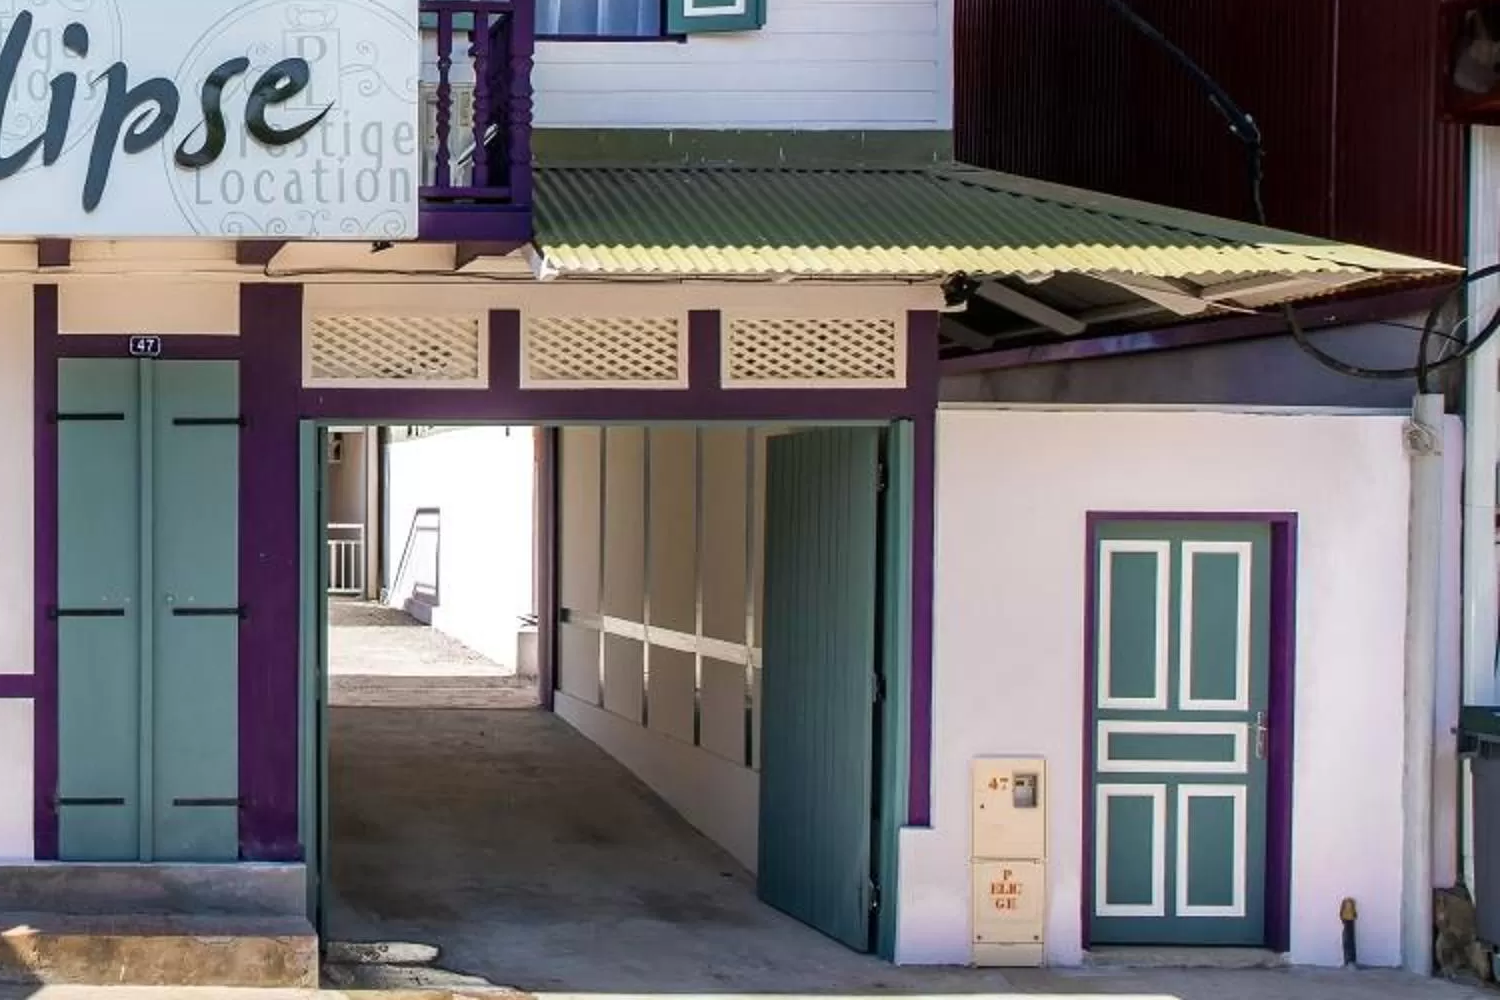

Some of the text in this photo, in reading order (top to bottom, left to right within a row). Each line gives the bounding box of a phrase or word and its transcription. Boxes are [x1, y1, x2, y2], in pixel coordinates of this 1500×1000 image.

[195, 157, 411, 205] Location
[137, 339, 155, 352] 47
[988, 777, 1009, 791] 47
